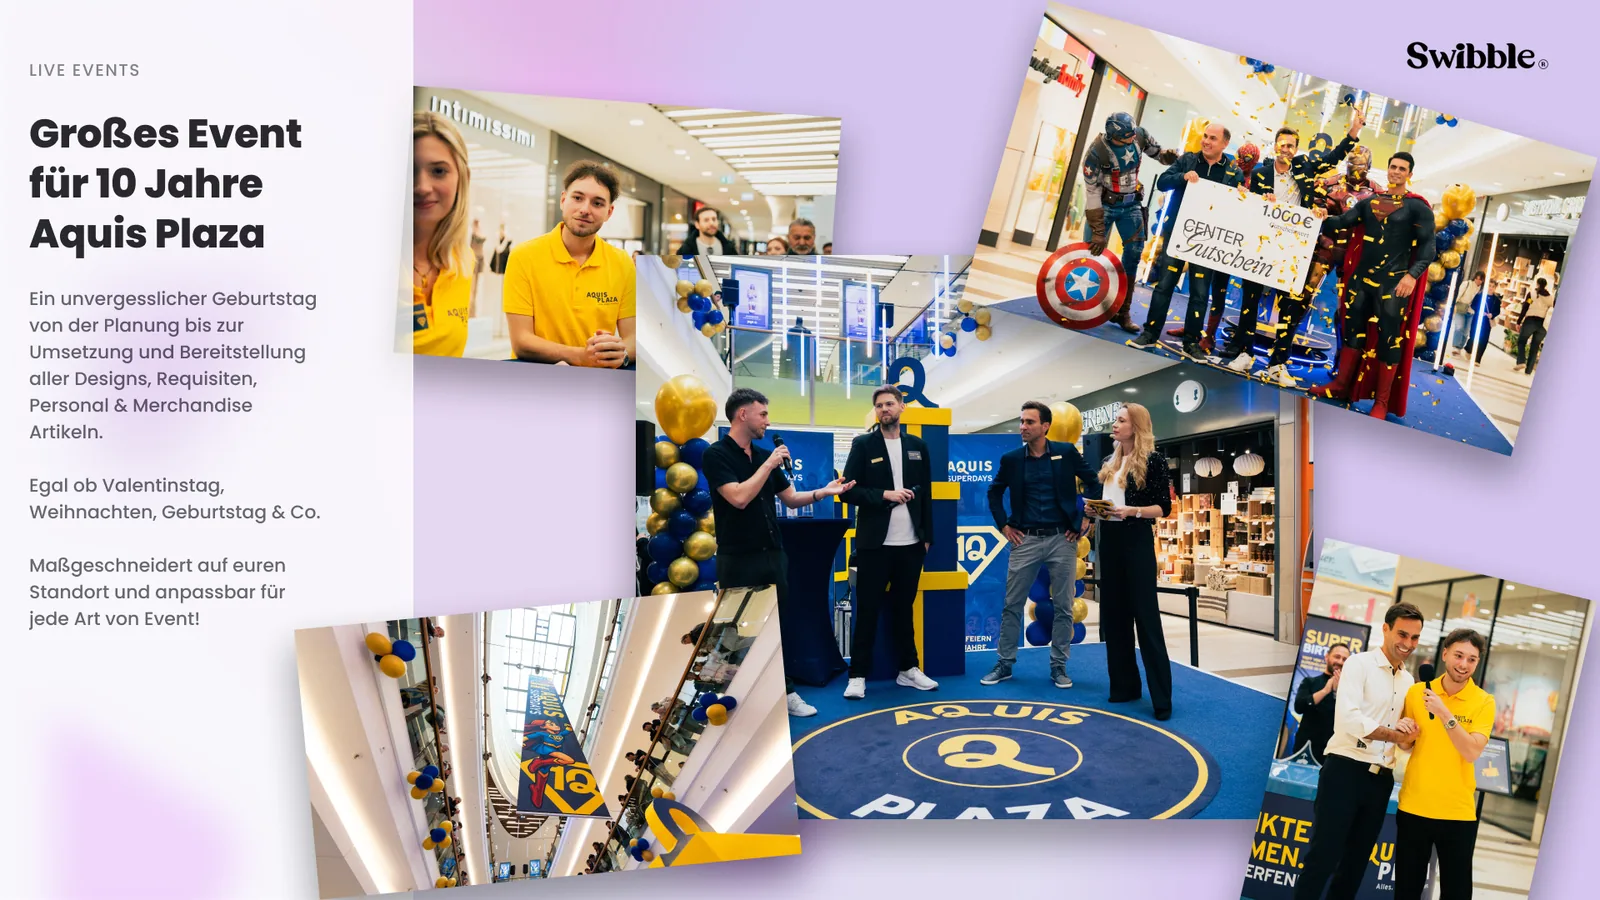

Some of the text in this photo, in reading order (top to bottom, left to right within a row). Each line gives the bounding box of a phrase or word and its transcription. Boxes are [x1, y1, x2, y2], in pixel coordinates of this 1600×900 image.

[1184, 218, 1244, 247] CENTER
[1176, 228, 1274, 277] Gutschein
[948, 461, 993, 474] AQUIS
[895, 704, 1091, 726] AQUIS
[1245, 864, 1299, 888] ERFEN
